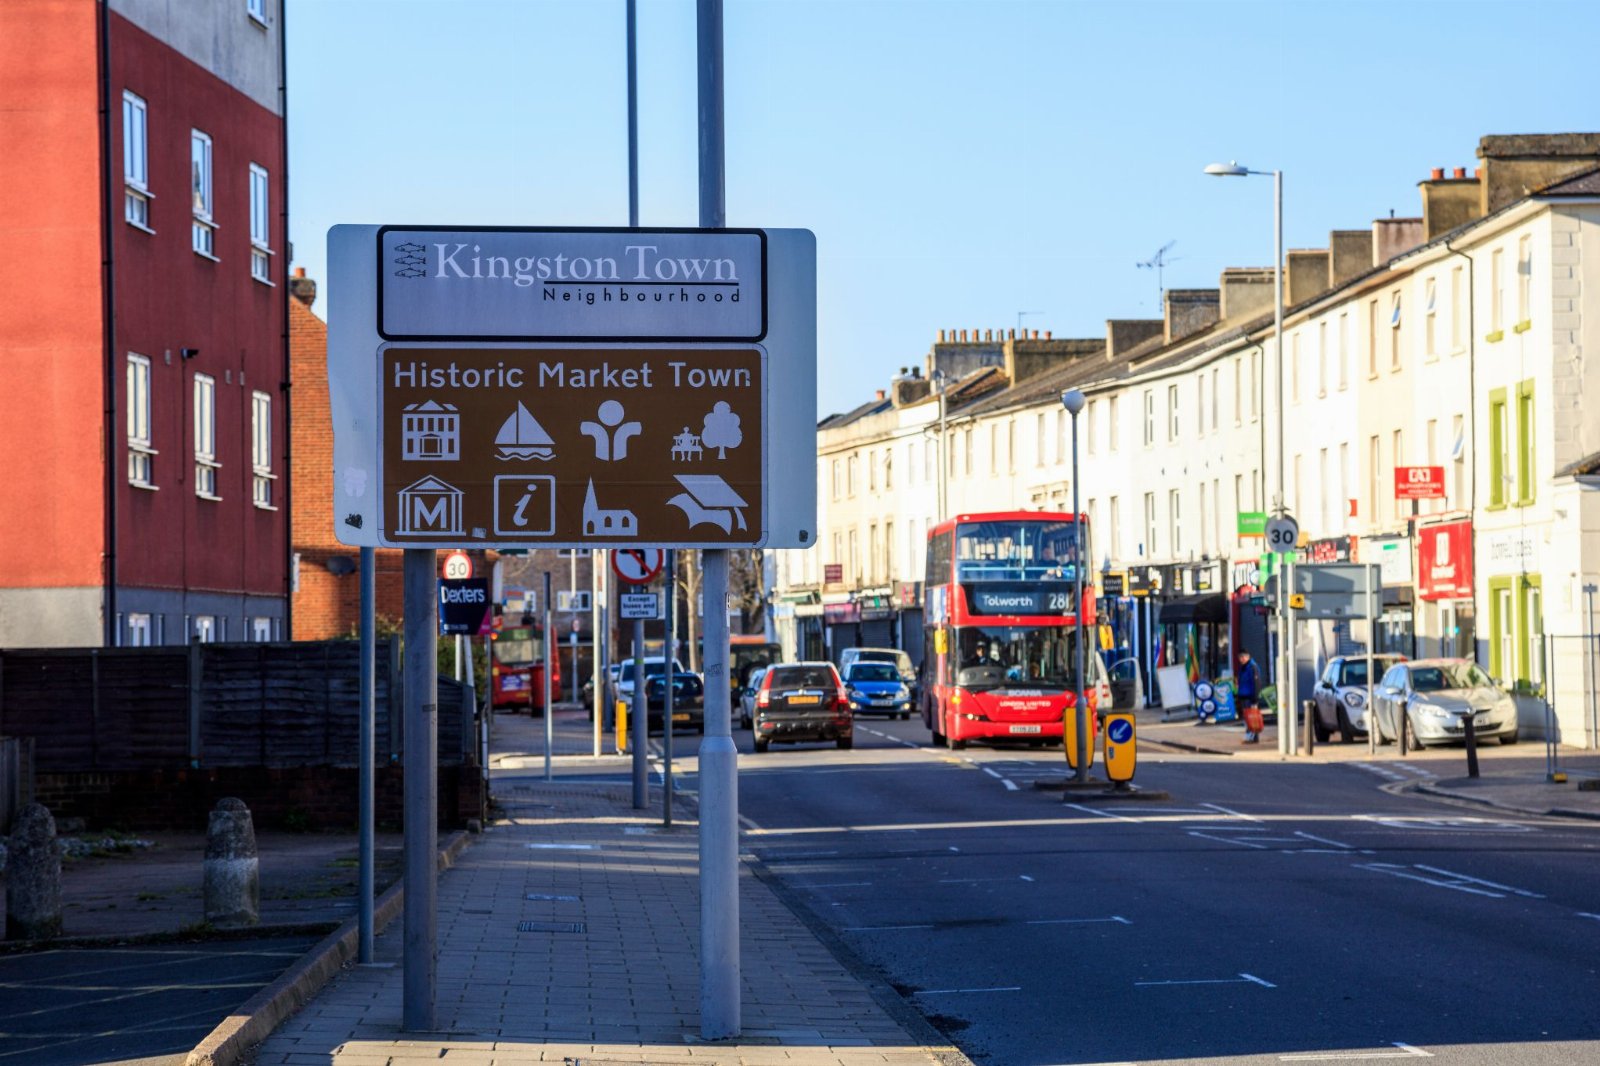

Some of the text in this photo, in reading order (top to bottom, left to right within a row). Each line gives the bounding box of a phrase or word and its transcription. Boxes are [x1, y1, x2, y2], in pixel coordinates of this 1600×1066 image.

[433, 242, 739, 287] Kingston Town
[542, 287, 741, 304] Neighbourhood
[394, 361, 752, 389] Historic Market Town
[1271, 528, 1295, 545] 30
[448, 562, 467, 577] 30
[440, 585, 486, 604] Dexters
[982, 594, 1033, 607] Tolworth
[1049, 593, 1070, 610] 281
